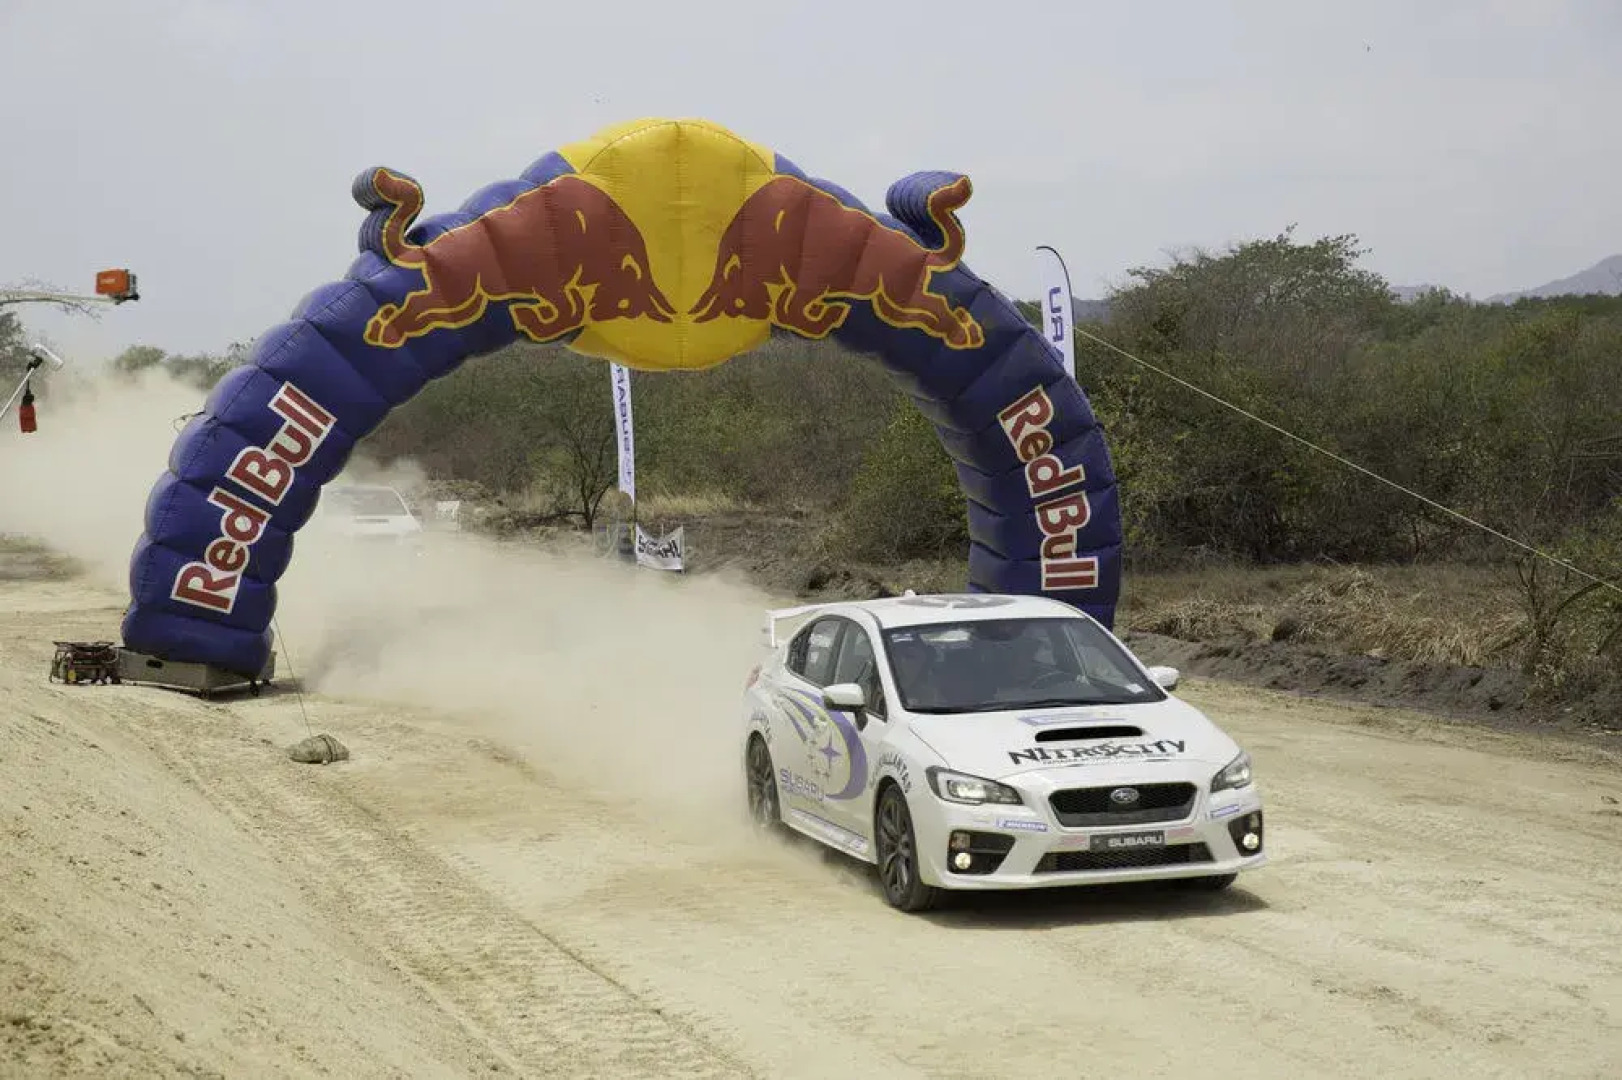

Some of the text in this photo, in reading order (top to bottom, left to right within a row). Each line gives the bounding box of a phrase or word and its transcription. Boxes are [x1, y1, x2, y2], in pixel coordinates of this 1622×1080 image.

[170, 381, 338, 614] Red Bull
[997, 385, 1099, 591] Red Bull
[1107, 834, 1163, 848] SUBARU
